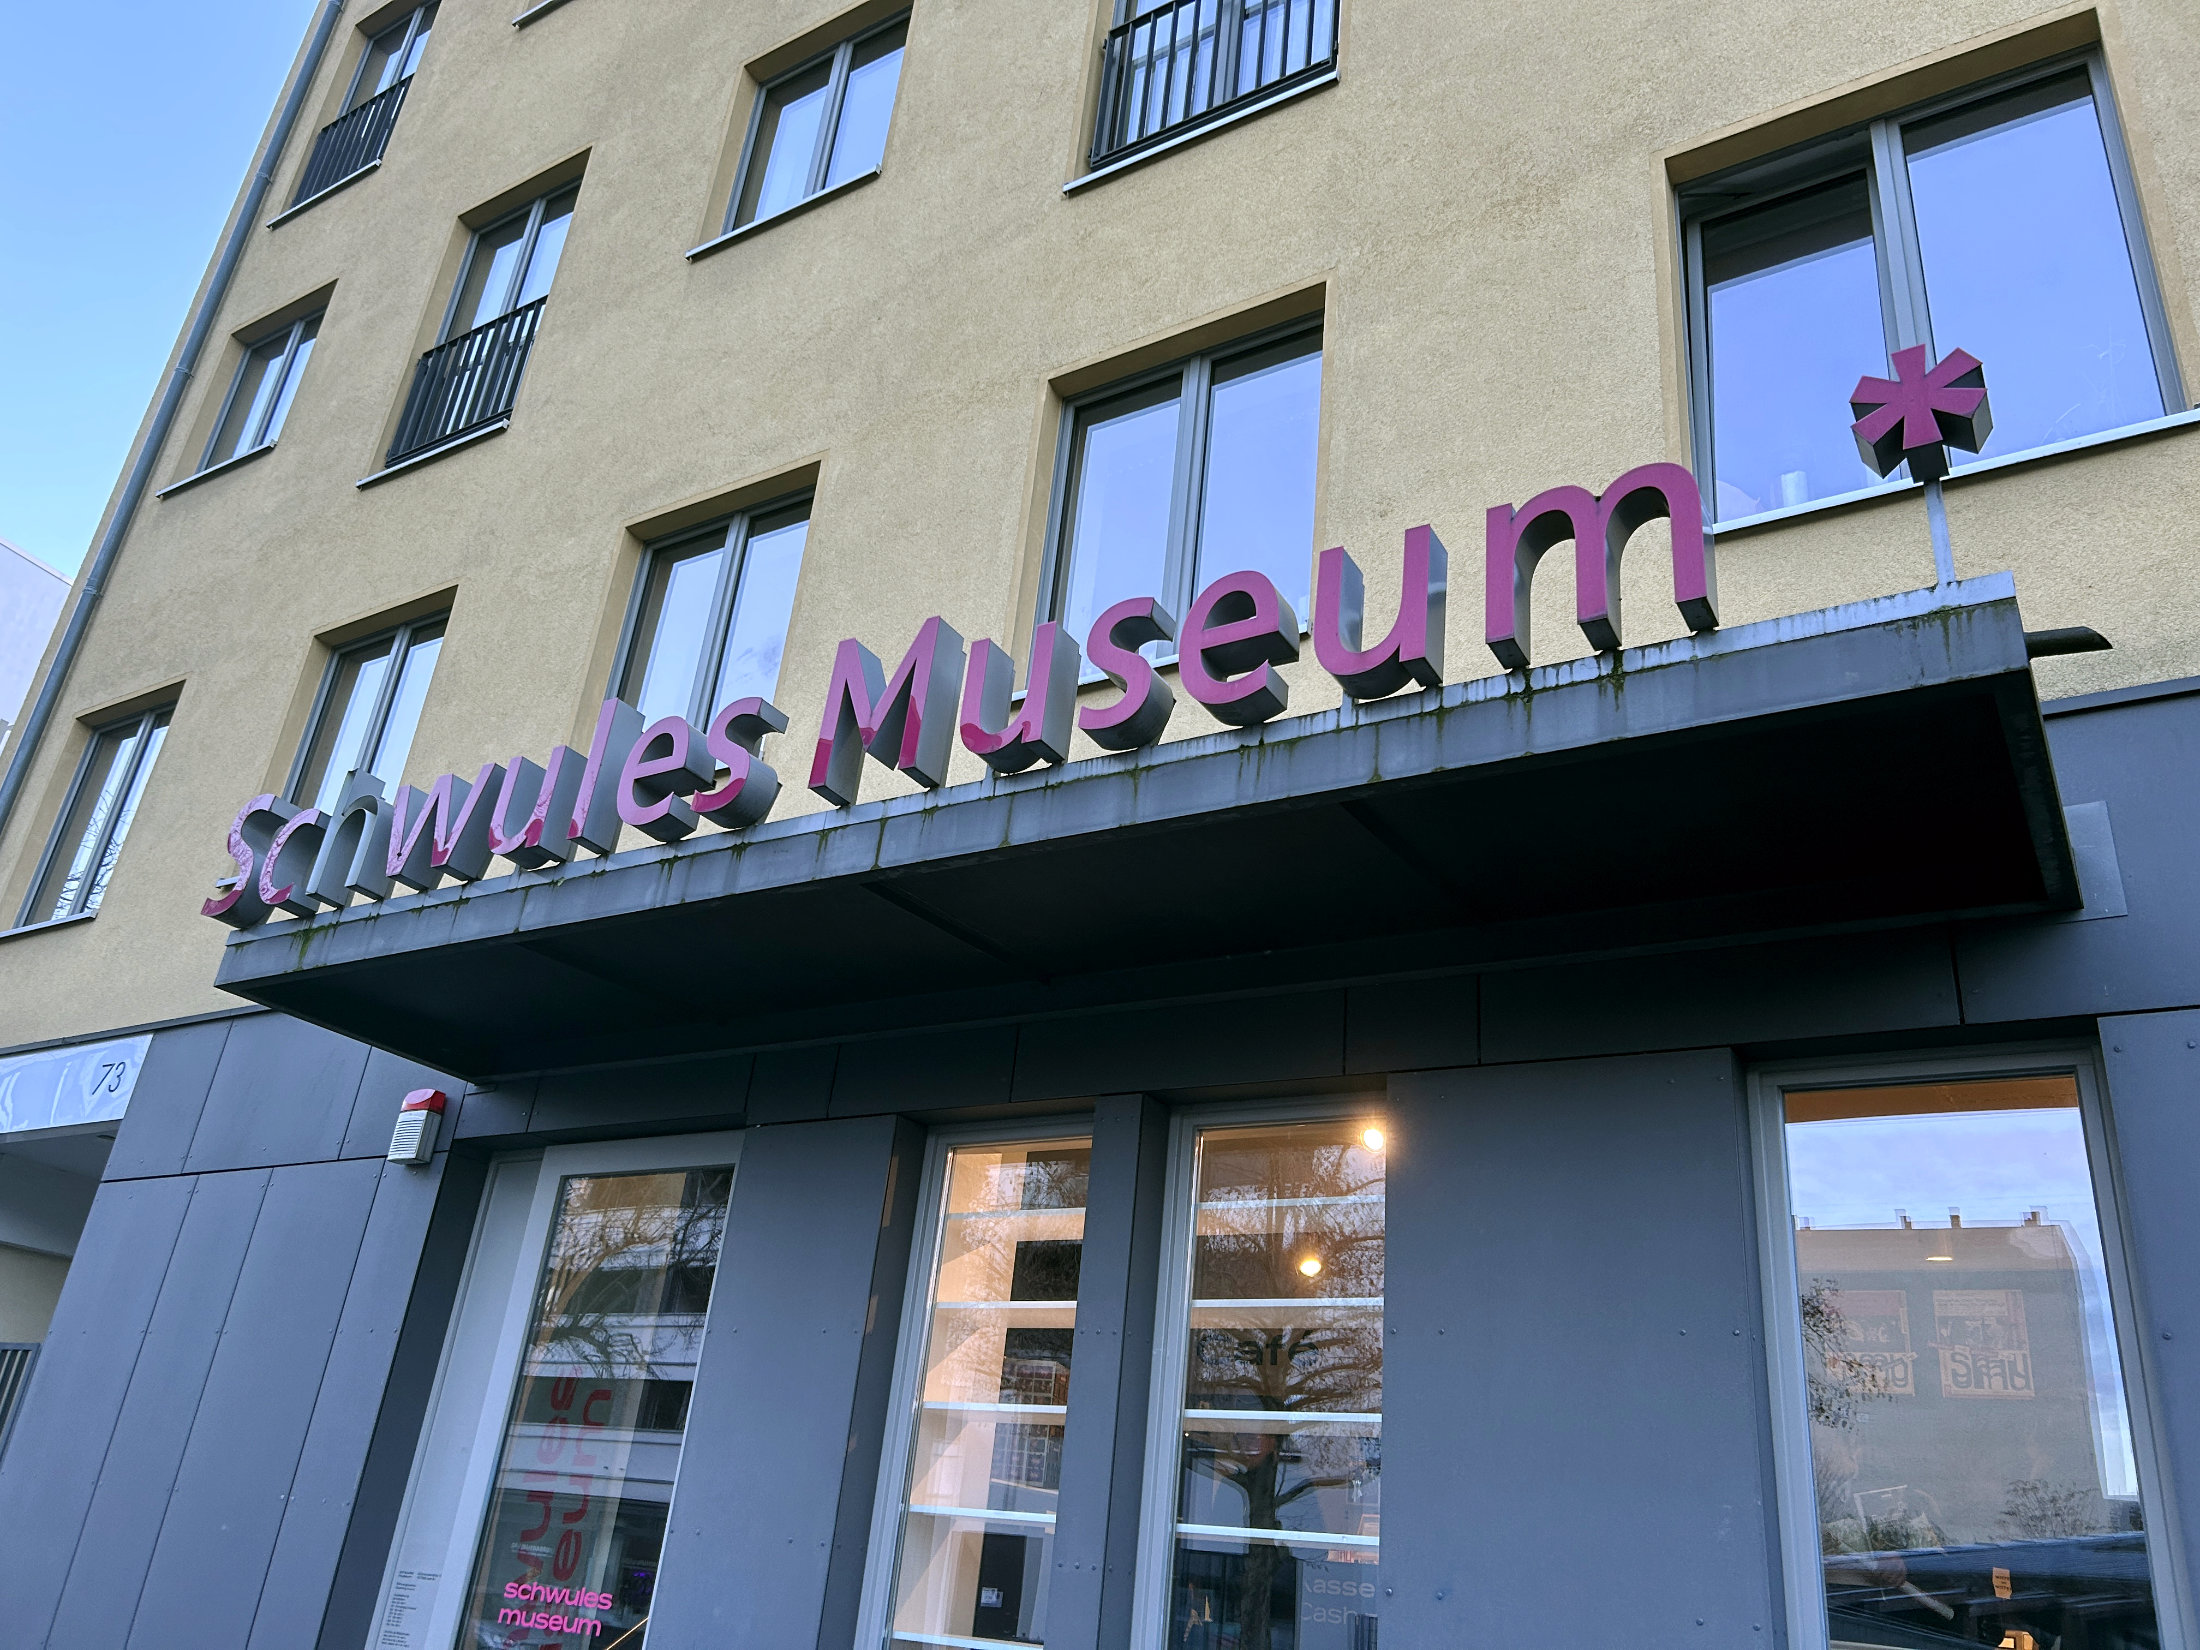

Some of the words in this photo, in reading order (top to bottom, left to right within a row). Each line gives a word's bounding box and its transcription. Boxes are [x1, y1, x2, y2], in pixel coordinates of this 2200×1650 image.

[201, 697, 786, 927] Schwules
[808, 462, 1720, 806] Museum
[91, 1061, 126, 1096] 73
[503, 1581, 614, 1612] schwules
[497, 1607, 602, 1637] museum
